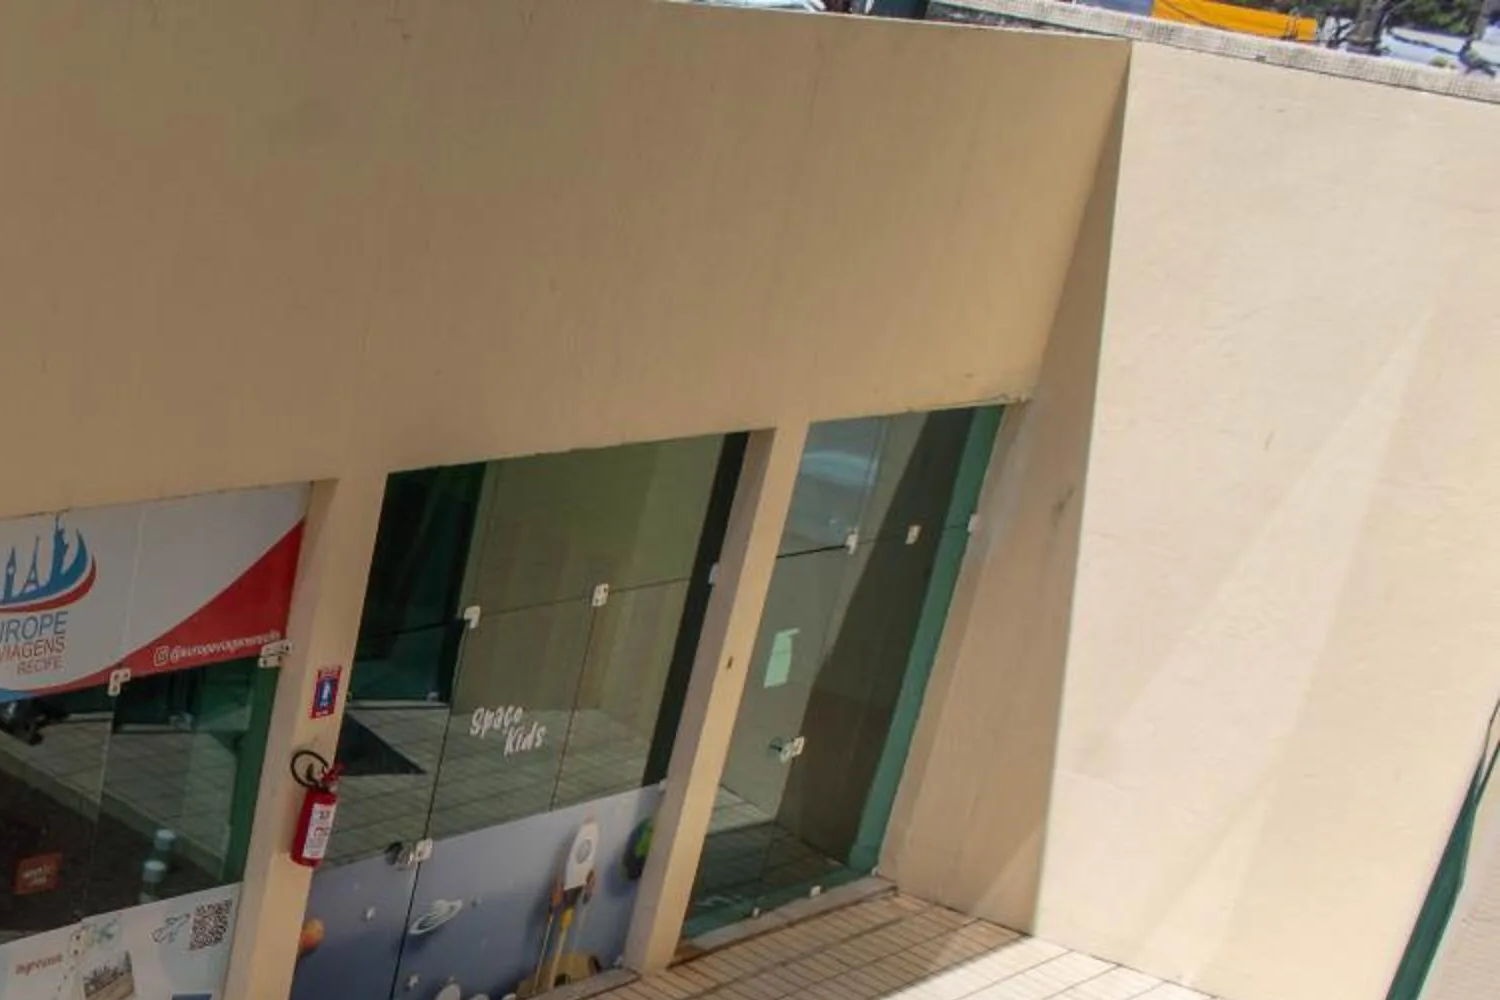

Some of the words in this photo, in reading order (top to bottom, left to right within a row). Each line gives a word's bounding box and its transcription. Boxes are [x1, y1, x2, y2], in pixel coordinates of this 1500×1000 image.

[16, 656, 64, 675] RECIFE
[469, 705, 523, 740] Space
[503, 721, 547, 757] Kids
